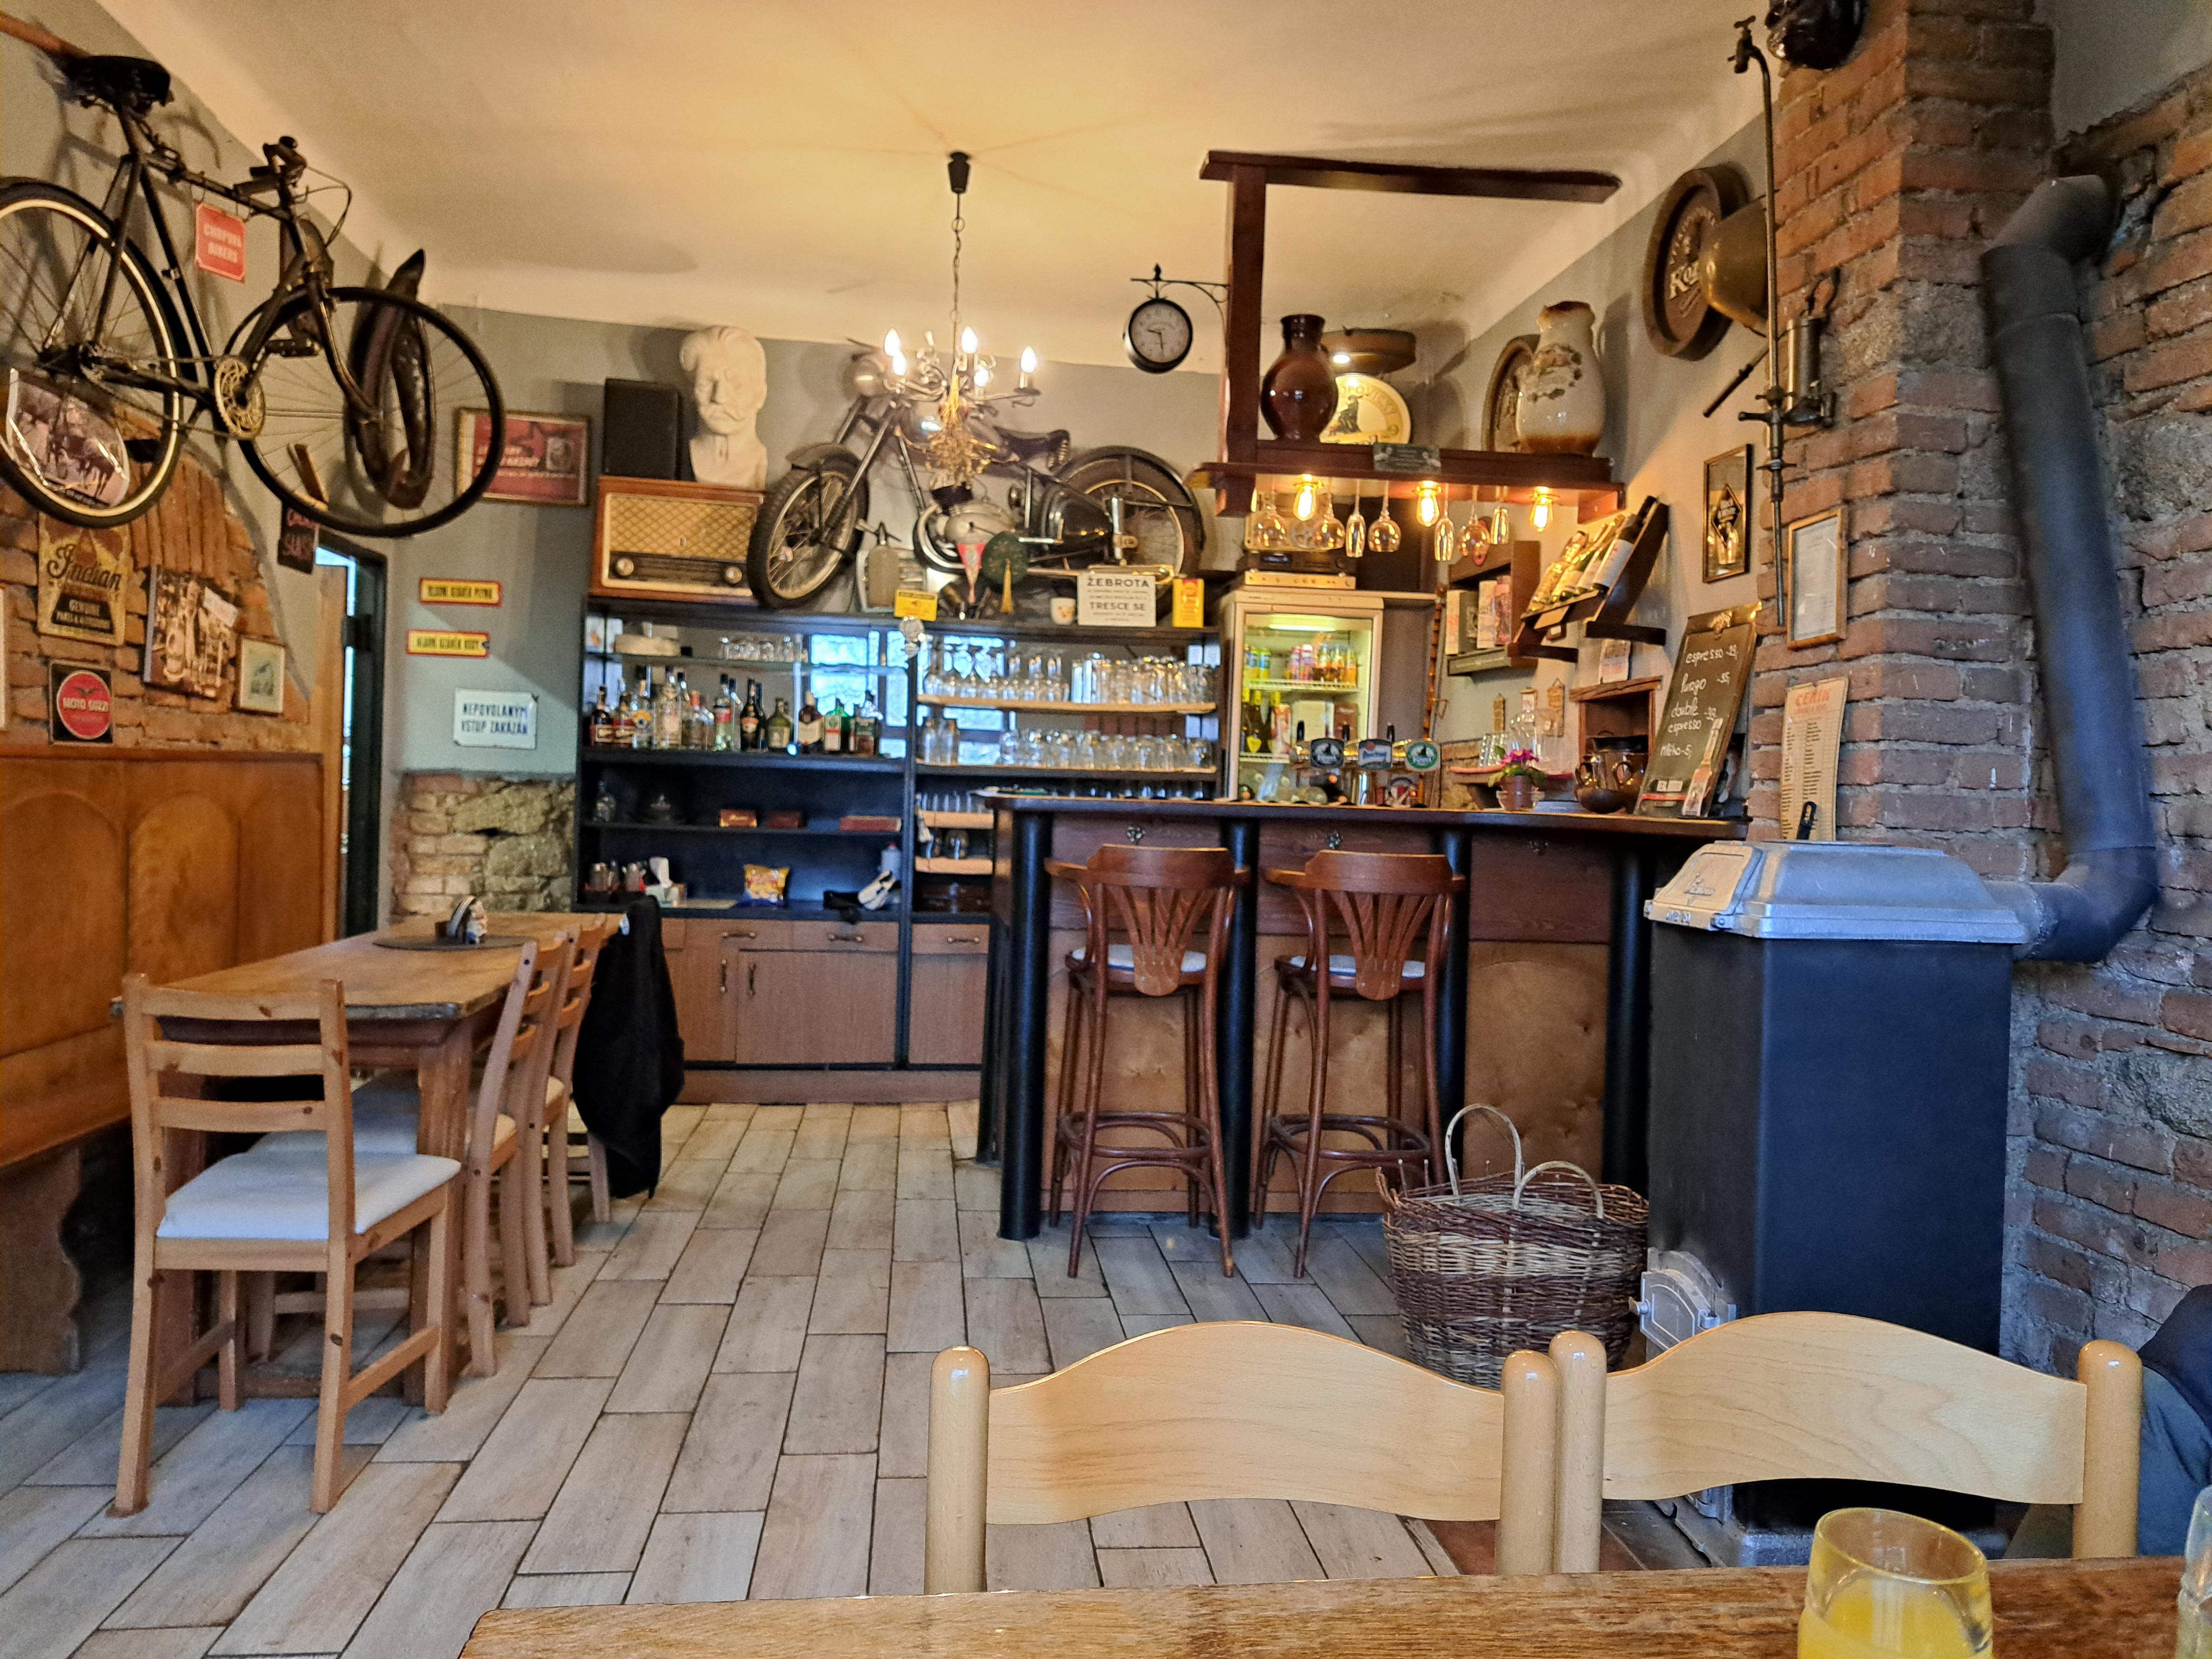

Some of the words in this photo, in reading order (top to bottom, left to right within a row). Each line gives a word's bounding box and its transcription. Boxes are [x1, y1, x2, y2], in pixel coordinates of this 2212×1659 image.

[47, 544, 121, 591] Indian
[1087, 576, 1149, 588] ŽEBROTA
[1686, 648, 1724, 667] espresso
[1681, 672, 1707, 696] lungo
[62, 697, 86, 711] MOTO
[463, 703, 528, 718] NEPOVOLANÝM
[1671, 697, 1699, 718] double
[461, 720, 487, 732] VSTUP
[490, 721, 528, 734] ZAKÁZÁN
[1668, 719, 1702, 736] espresso
